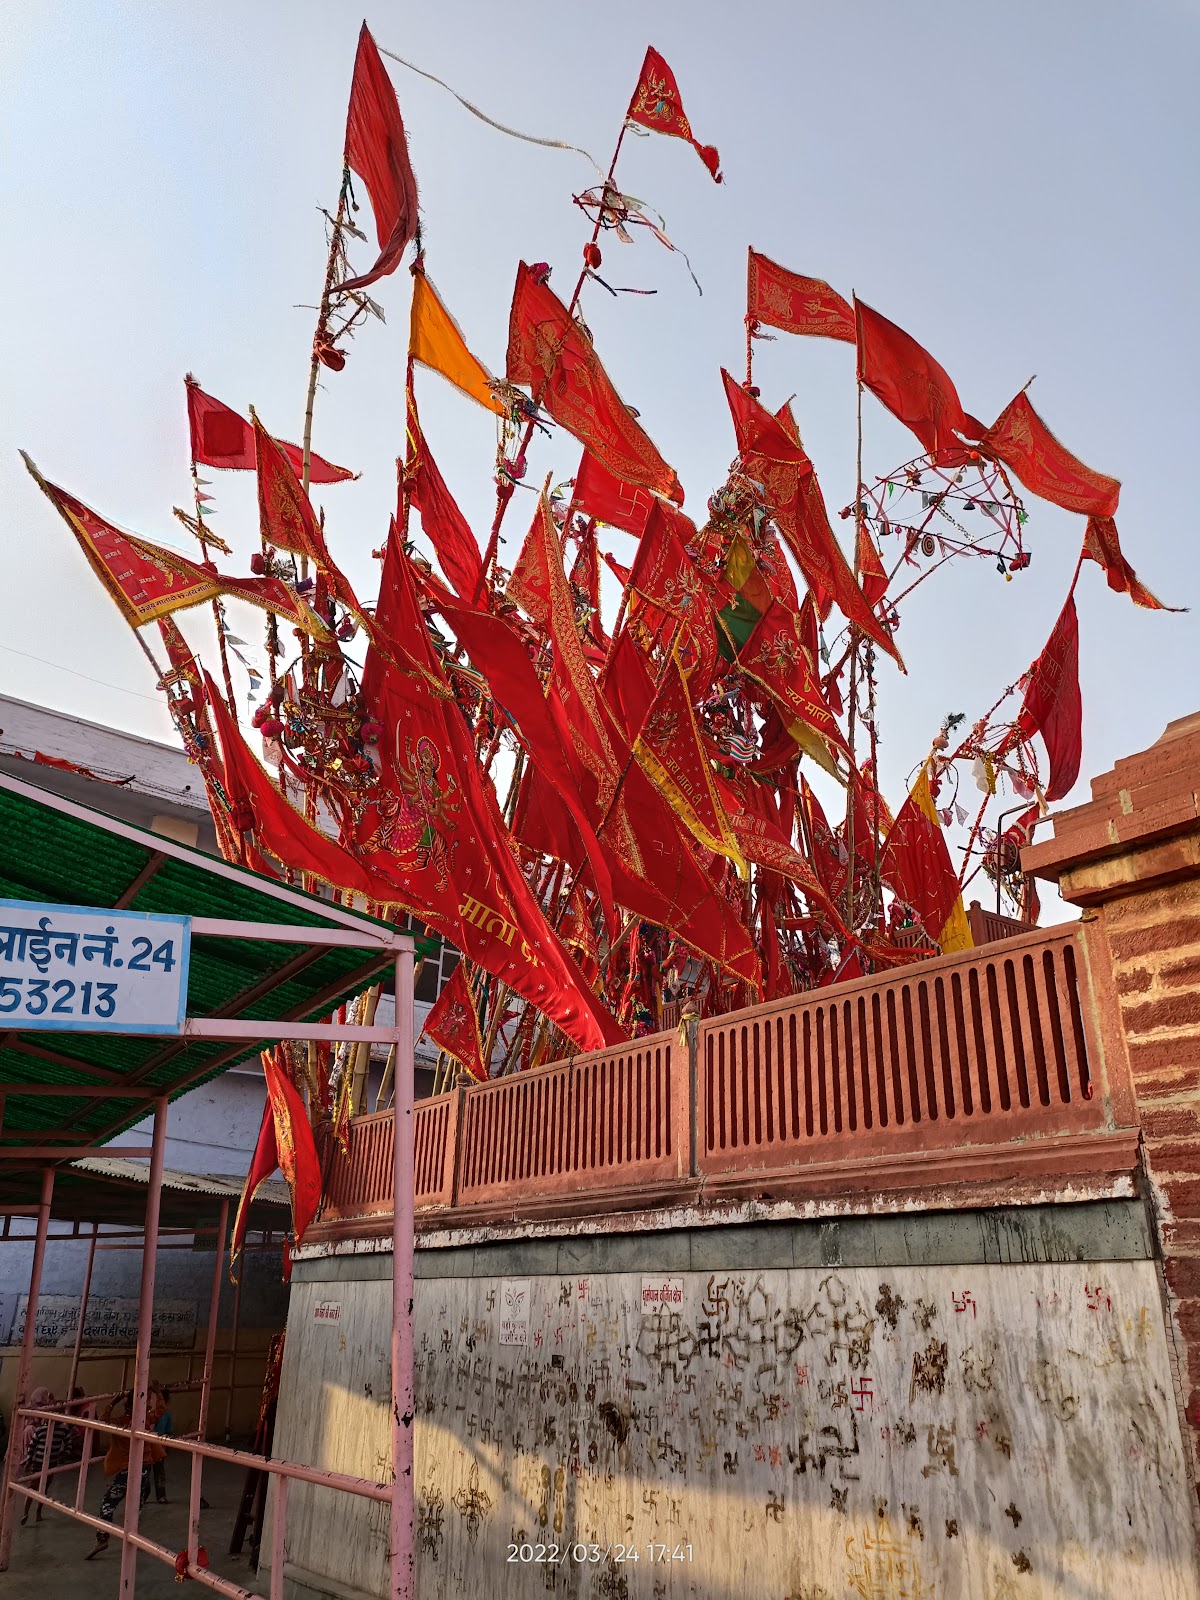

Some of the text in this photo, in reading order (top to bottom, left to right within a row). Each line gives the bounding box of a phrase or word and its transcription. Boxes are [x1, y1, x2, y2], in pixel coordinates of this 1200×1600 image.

[785, 685, 834, 723] जय माता
[666, 755, 681, 775] जय
[676, 771, 694, 796] माता
[458, 892, 519, 947] माता
[0, 976, 119, 1019] 53213
